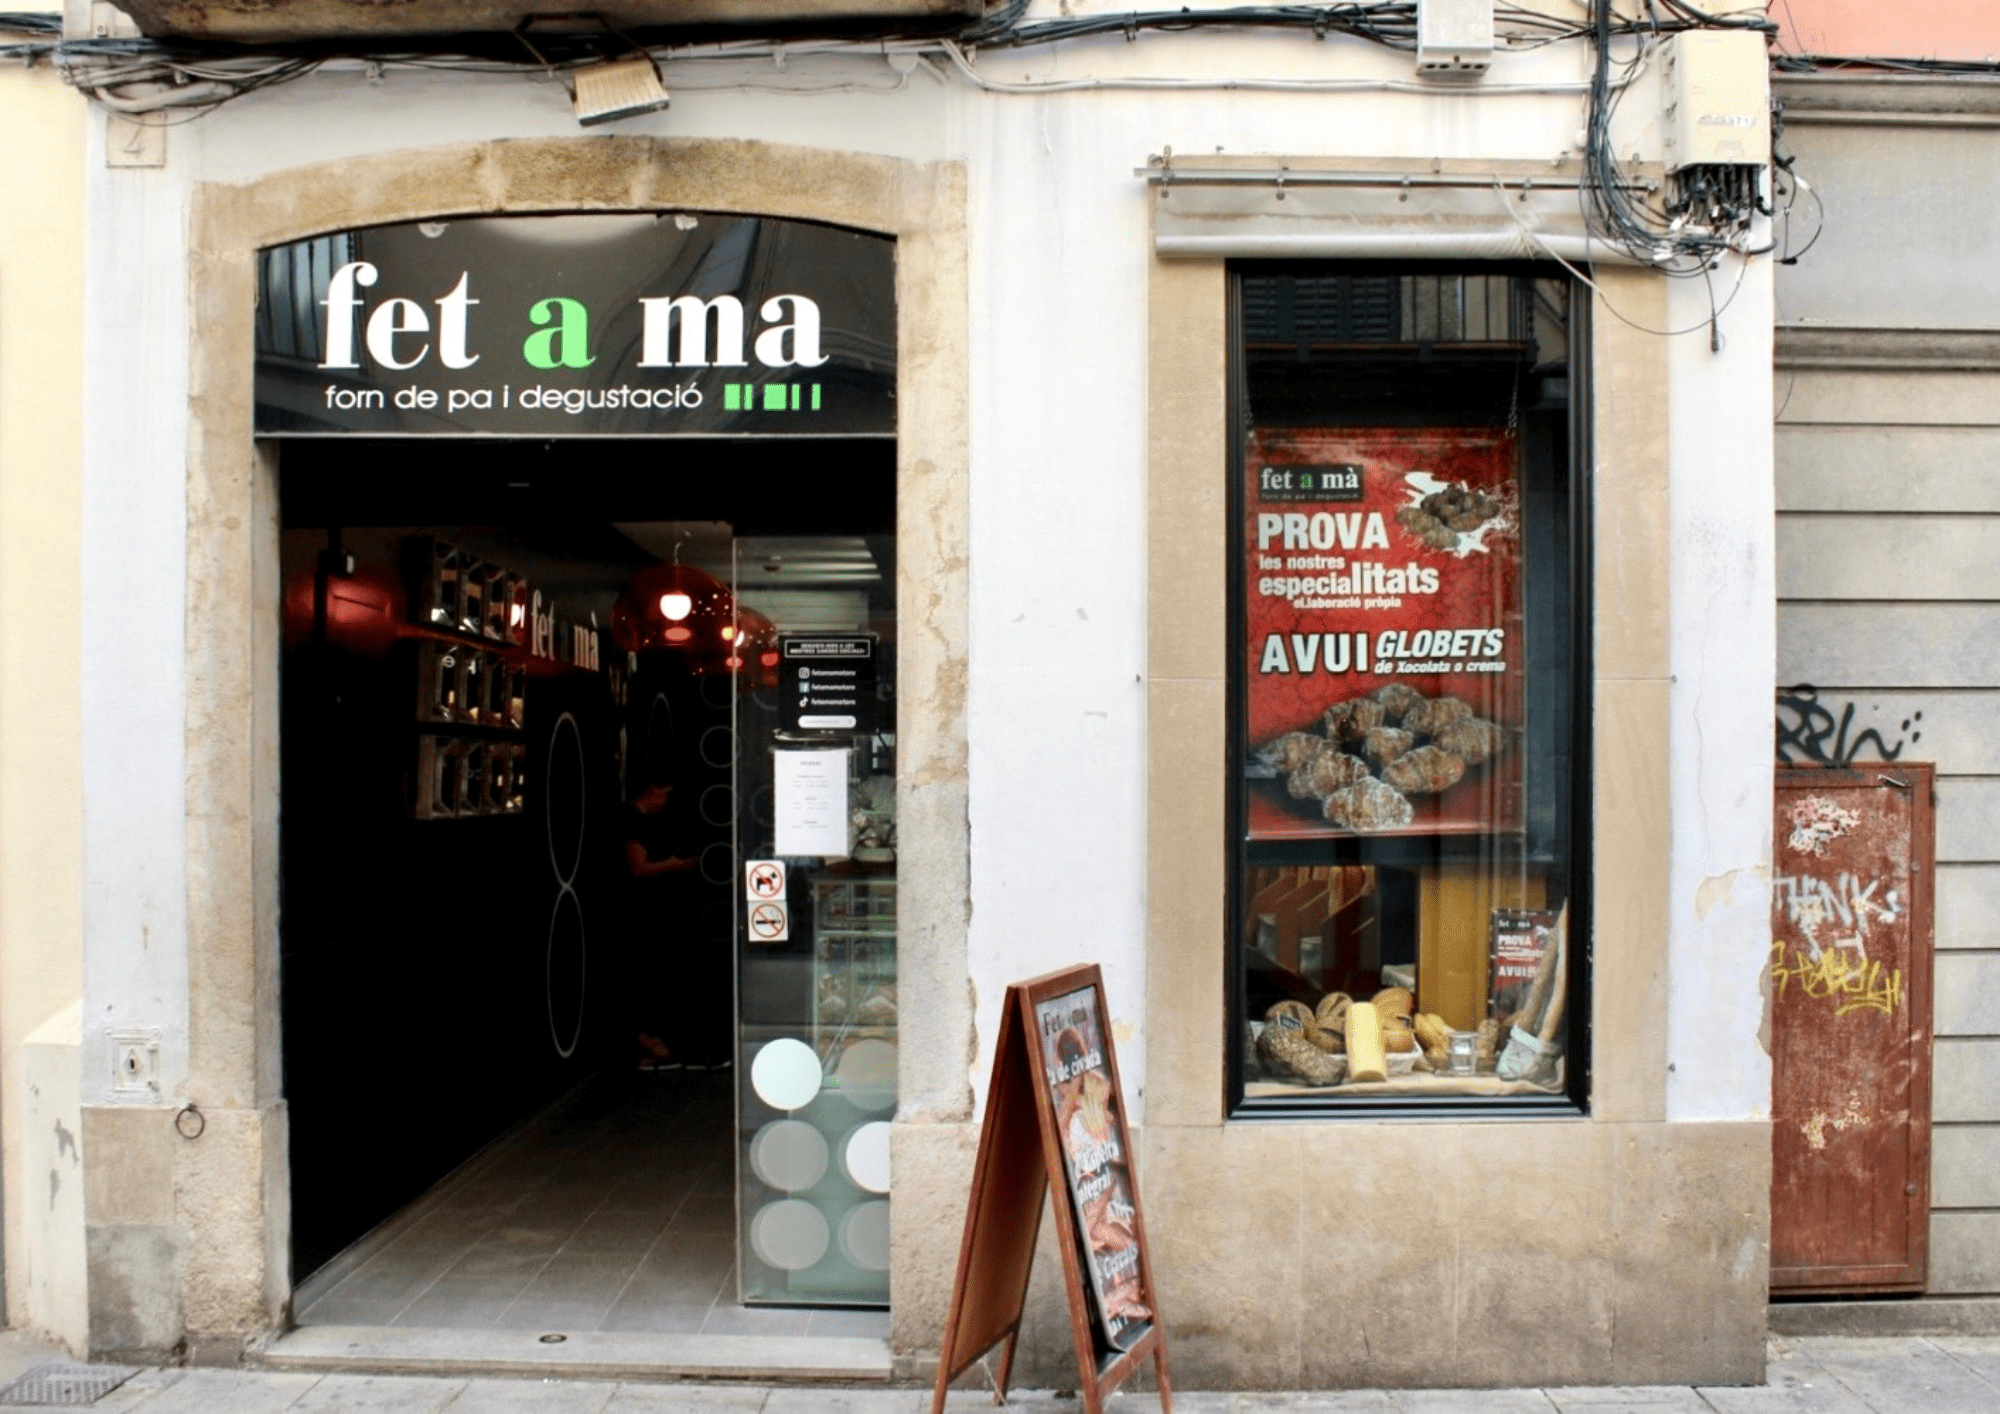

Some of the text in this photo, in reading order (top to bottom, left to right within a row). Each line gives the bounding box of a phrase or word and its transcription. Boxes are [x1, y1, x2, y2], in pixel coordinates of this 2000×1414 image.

[316, 261, 830, 371] fet a ma
[325, 382, 703, 415] forn de pa i degustació
[1261, 466, 1360, 490] fet a mà
[1258, 511, 1391, 551] PROVA
[1259, 553, 1346, 570] les nostres
[1259, 561, 1440, 600] especialitats
[531, 589, 554, 661] fet
[1259, 628, 1506, 674] AVUI GLOBETS
[1374, 659, 1507, 674] de Xocolata o crema
[1498, 934, 1532, 946] PROVA
